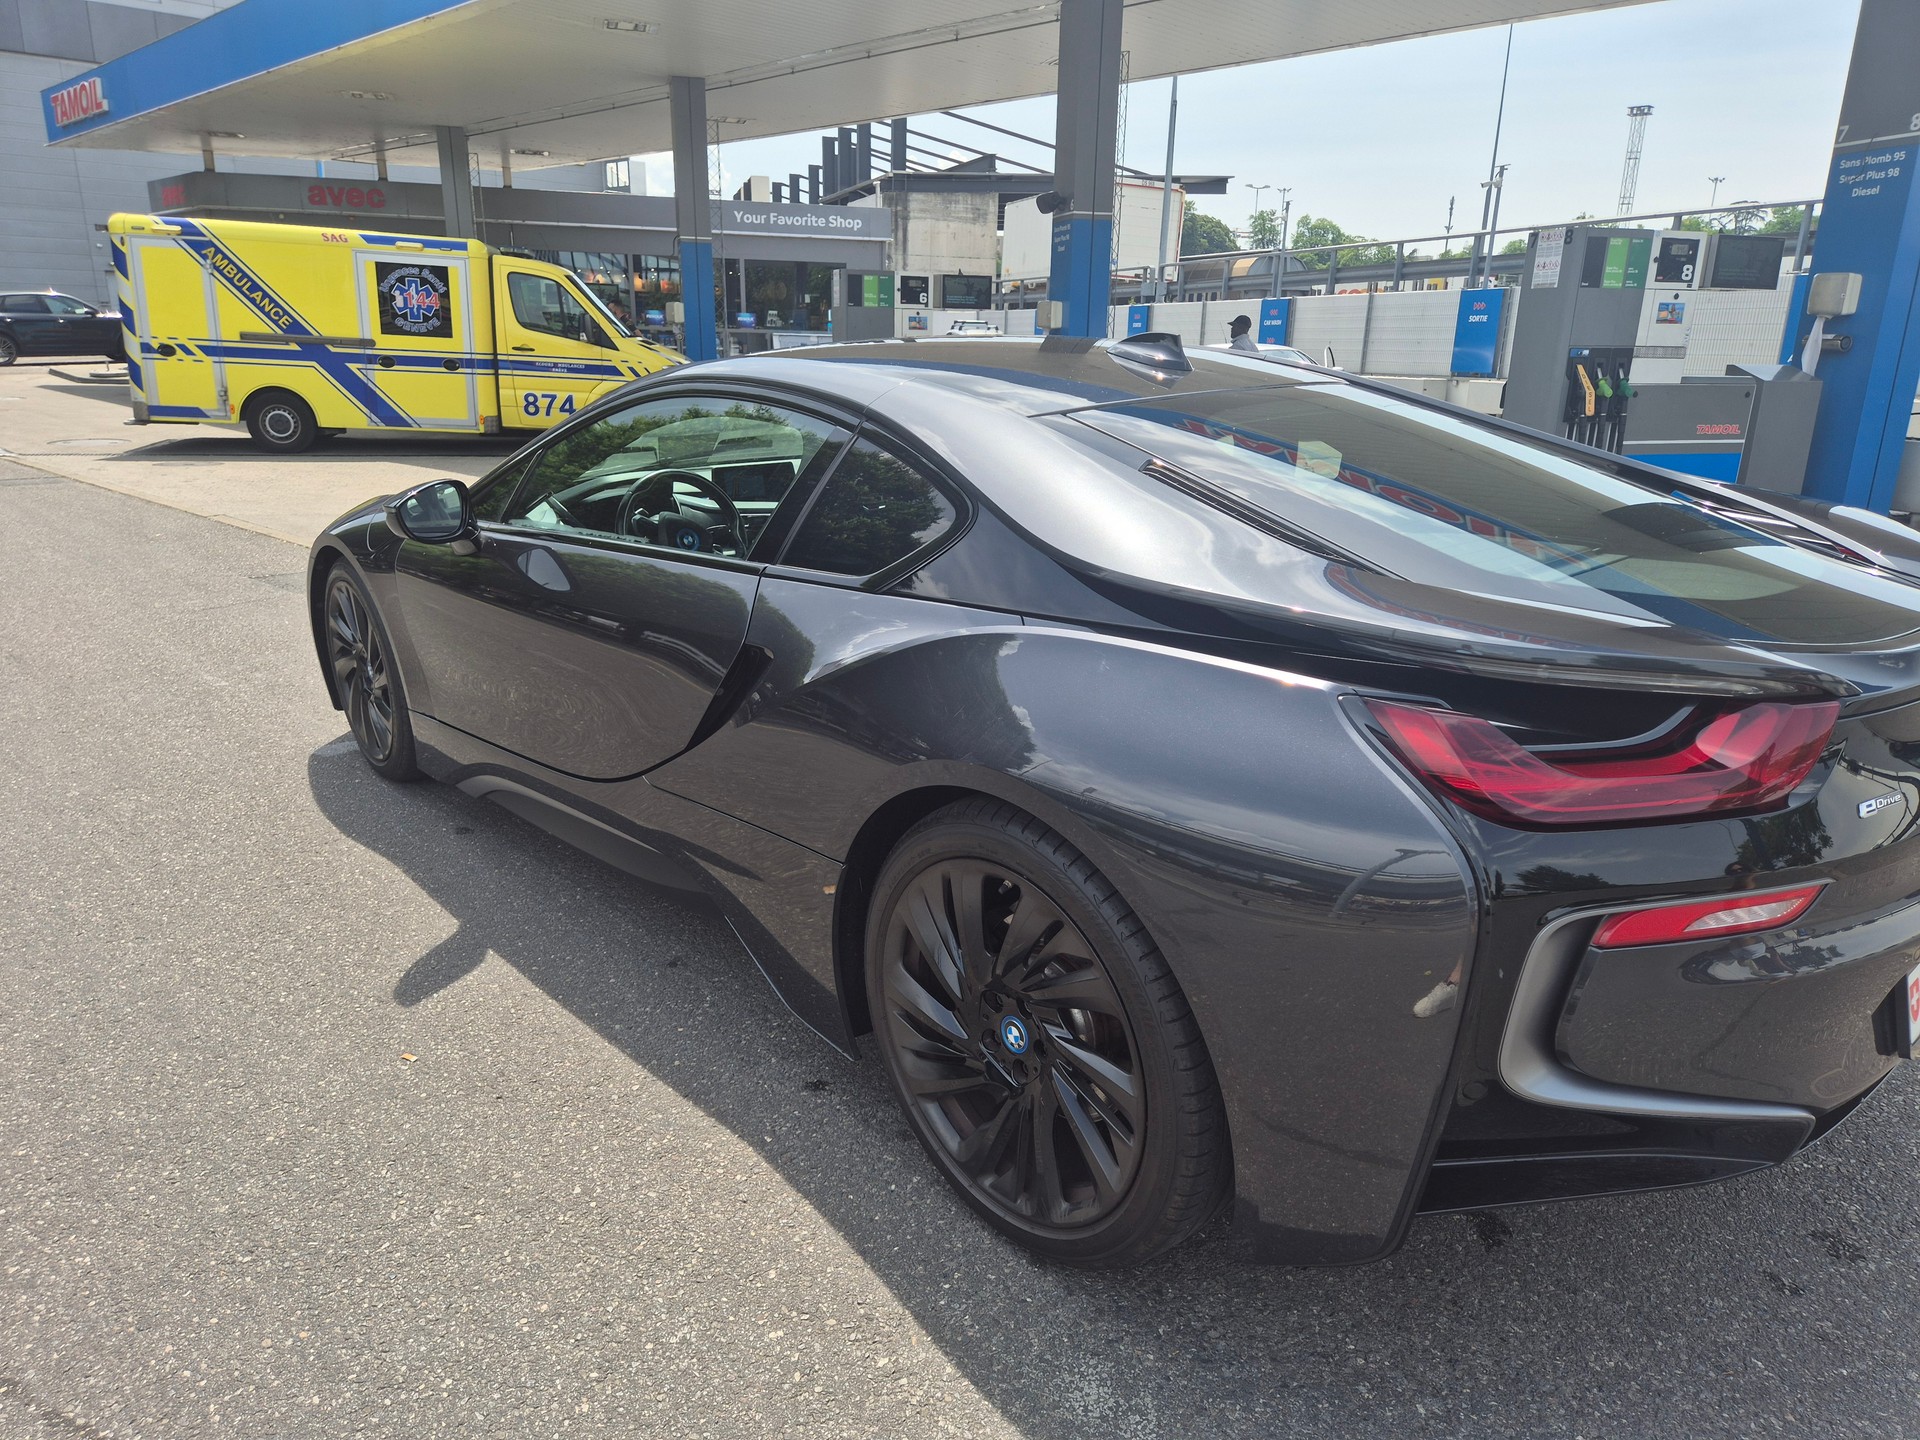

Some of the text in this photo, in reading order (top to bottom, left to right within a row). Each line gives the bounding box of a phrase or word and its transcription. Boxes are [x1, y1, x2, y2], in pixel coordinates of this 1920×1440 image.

[51, 78, 107, 126] TAMOIL
[1838, 113, 1920, 142] 7 8
[1839, 151, 1906, 169] Sans Plomb 95
[1839, 167, 1900, 184] Super Plus 98
[307, 184, 386, 209] avec
[1851, 185, 1880, 197] Diesel
[733, 210, 863, 231] Your Favorite Shop
[321, 232, 349, 244] SAG
[1530, 231, 1540, 249] 7
[1564, 229, 1574, 245] 8
[1681, 264, 1694, 281] 8
[201, 246, 293, 329] AMBULANCE
[403, 291, 441, 310] 144
[919, 292, 929, 304] 6
[1468, 314, 1489, 323] SORTIE
[522, 391, 578, 418] 874
[1695, 423, 1741, 435] TAMOIL
